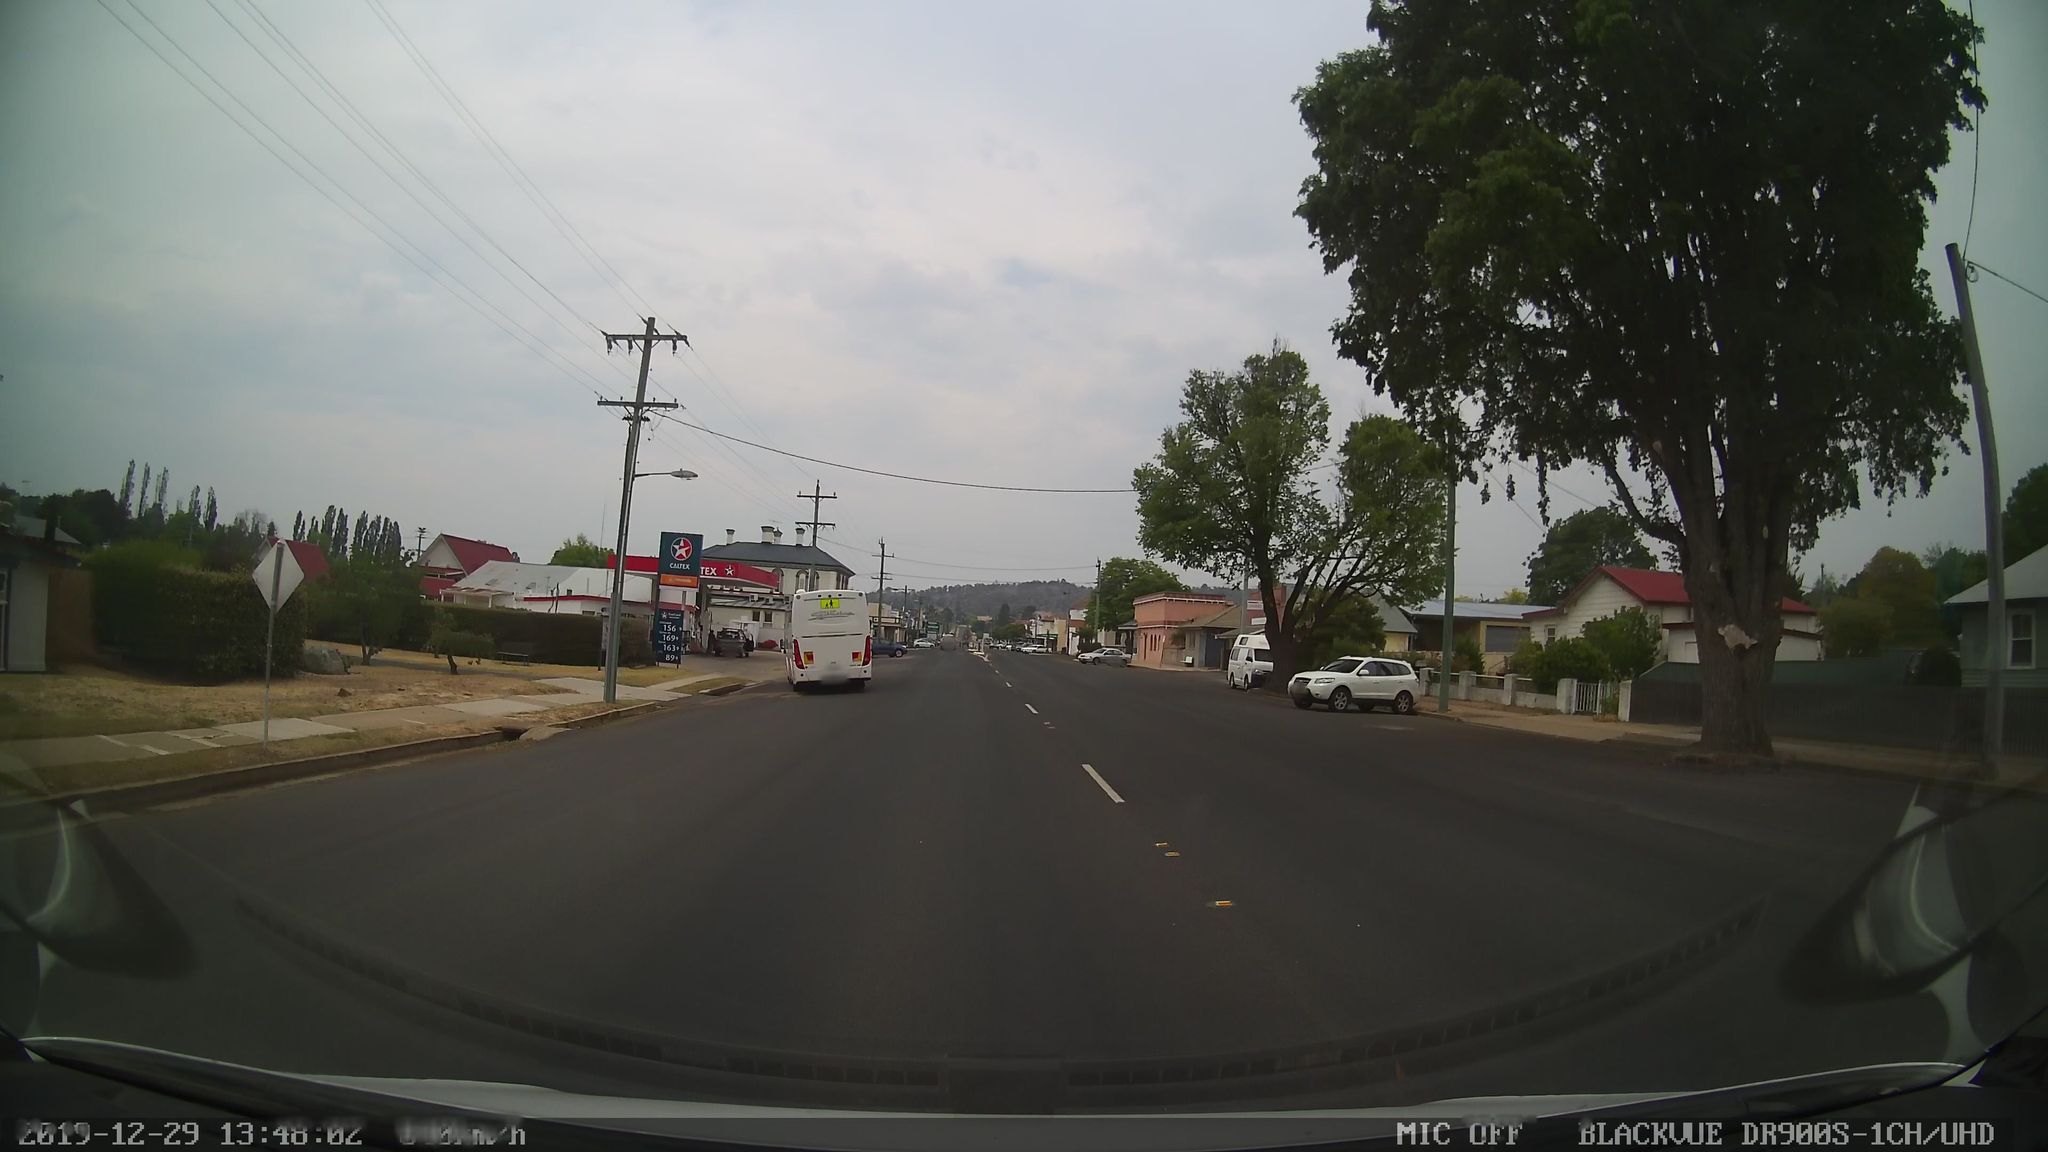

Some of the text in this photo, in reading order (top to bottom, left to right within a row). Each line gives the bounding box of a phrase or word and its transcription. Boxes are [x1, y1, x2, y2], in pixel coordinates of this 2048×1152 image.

[669, 562, 690, 570] CALTEX
[700, 566, 717, 576] TEX
[663, 624, 676, 632] 156
